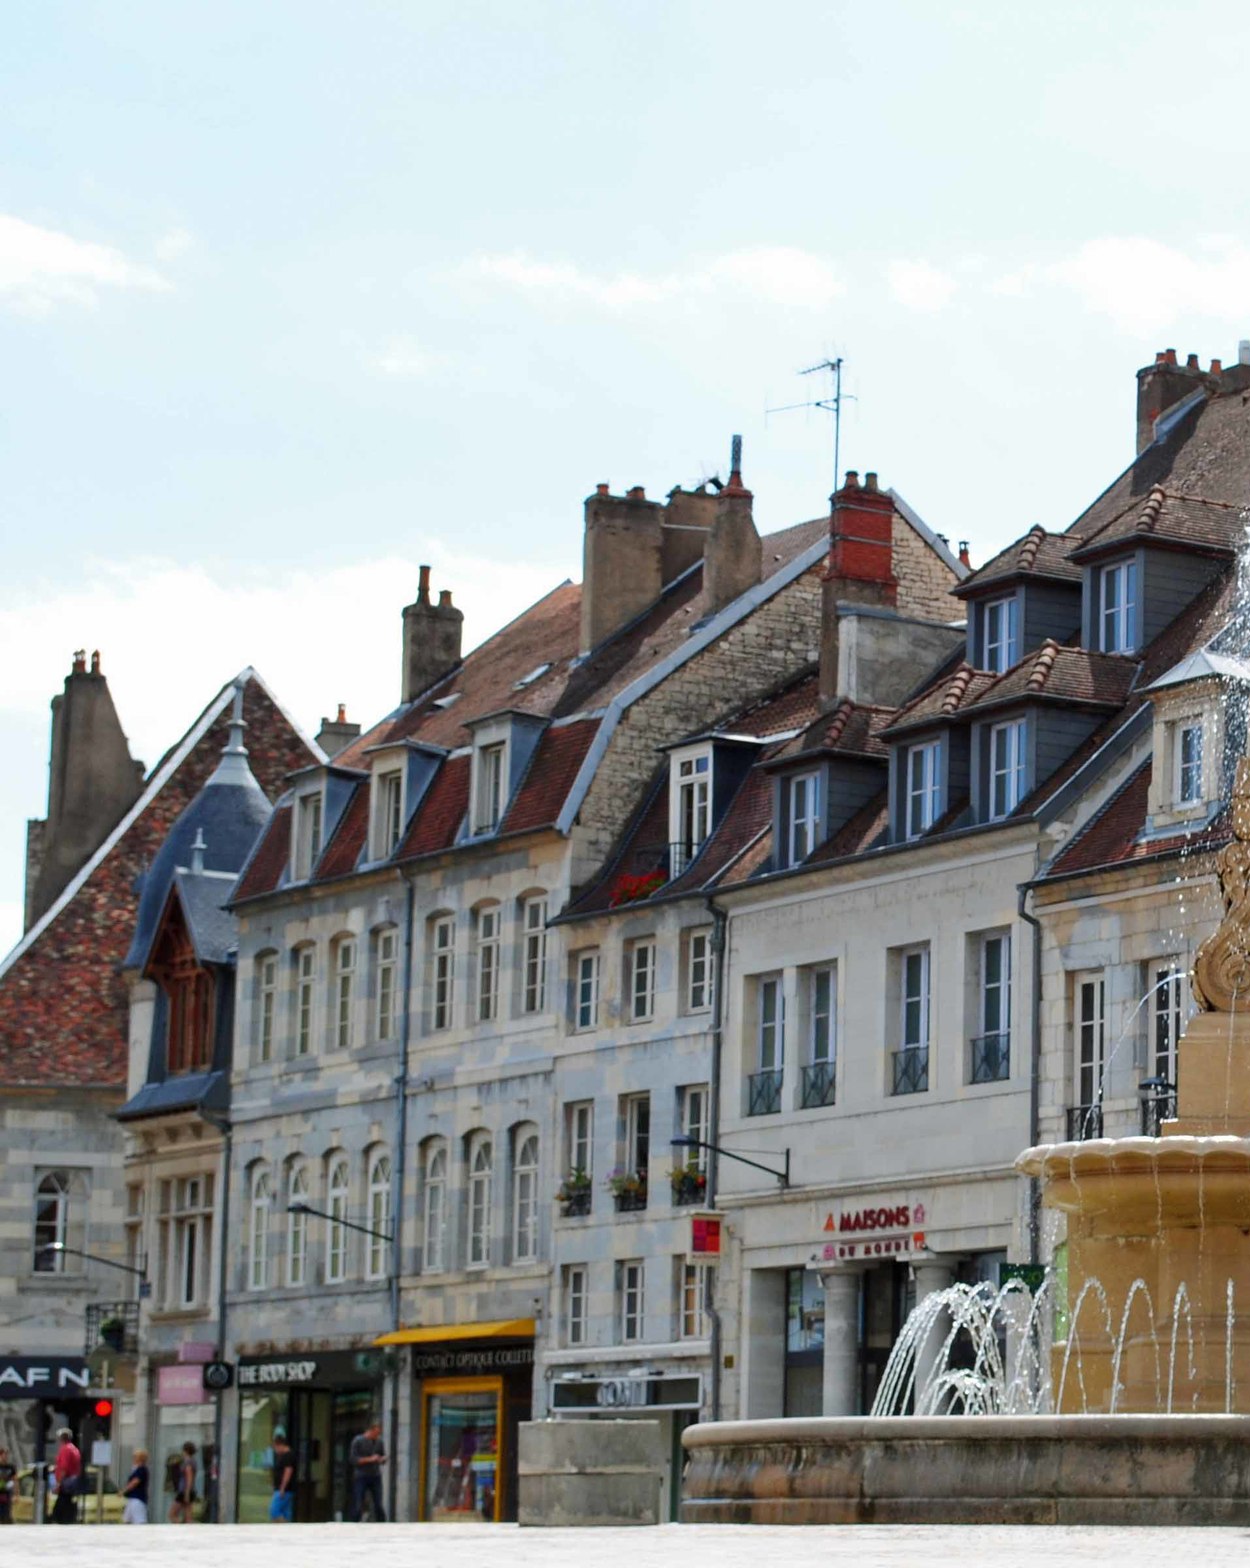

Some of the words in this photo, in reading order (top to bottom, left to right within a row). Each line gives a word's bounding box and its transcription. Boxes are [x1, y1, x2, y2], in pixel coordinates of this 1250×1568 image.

[839, 1205, 911, 1232] MAISONS
[839, 1245, 856, 1258] DU
[864, 1239, 910, 1256] MONDE
